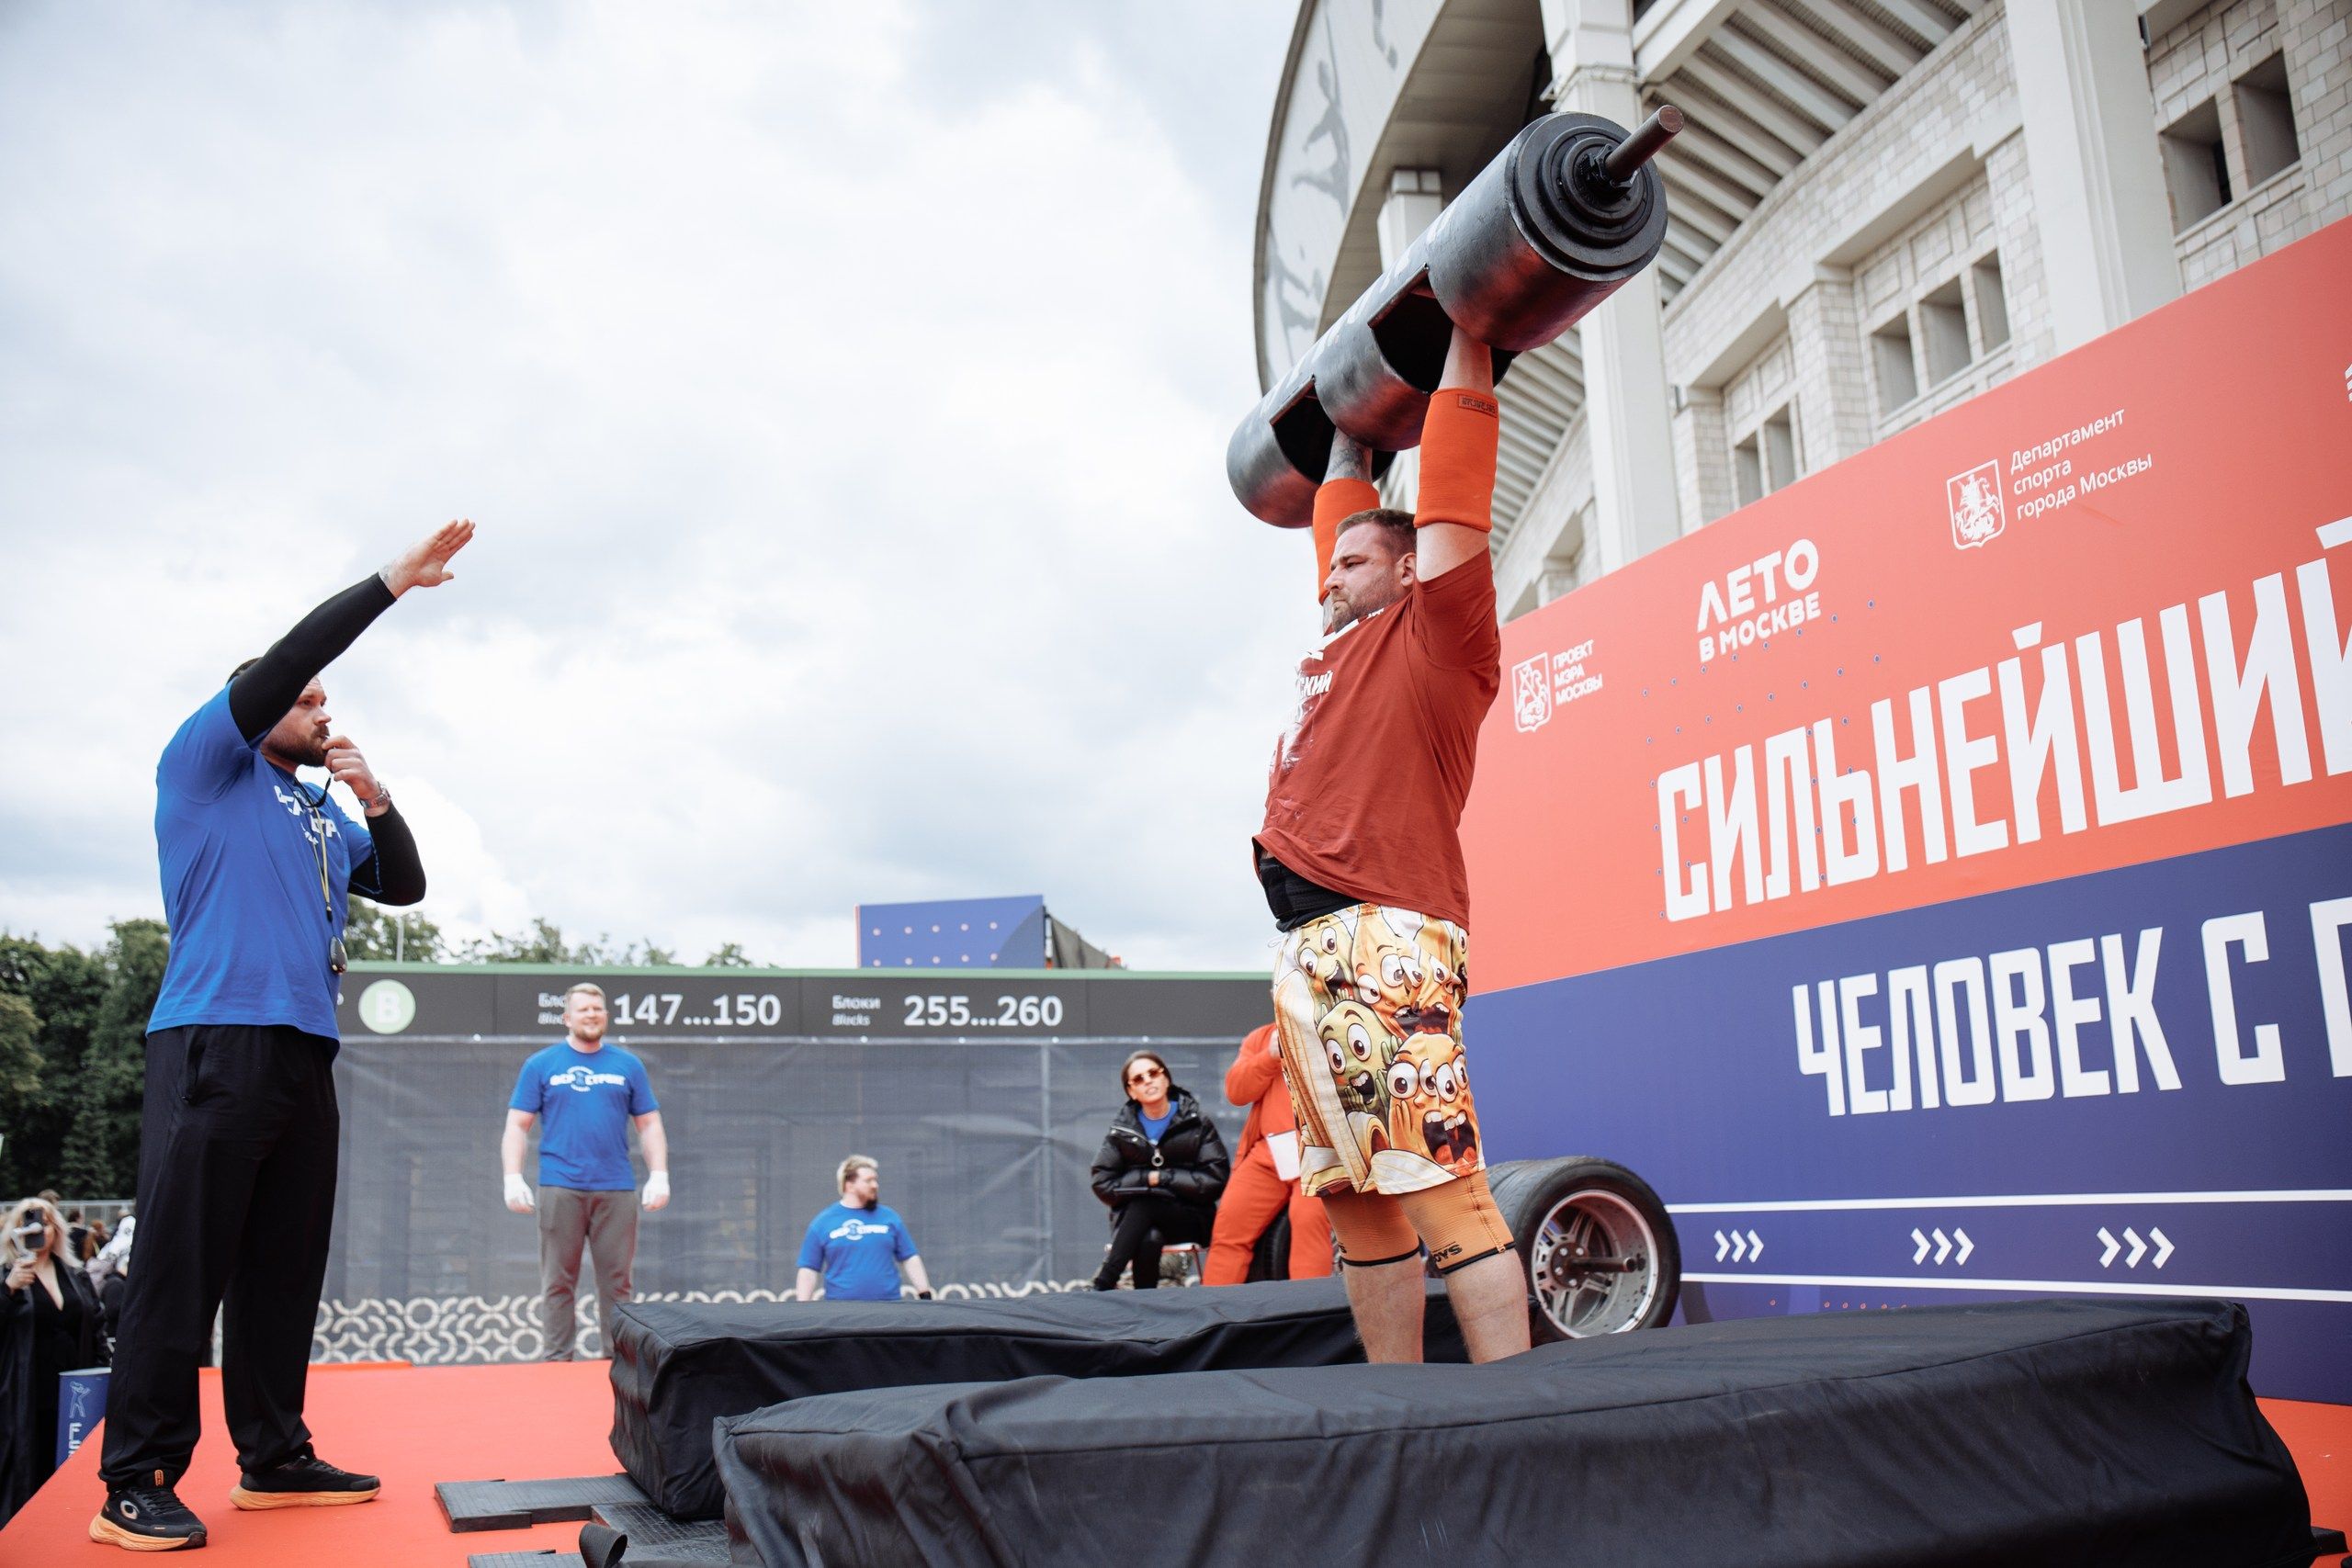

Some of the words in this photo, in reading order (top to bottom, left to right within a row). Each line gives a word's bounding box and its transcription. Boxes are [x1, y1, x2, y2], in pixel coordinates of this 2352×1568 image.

[2010, 409, 2124, 475] Департамент
[2013, 459, 2072, 495] спорта
[2017, 484, 2076, 521] города
[2079, 453, 2153, 496] Москвы
[1697, 538, 1819, 633] ЛЕТО
[1699, 636, 1715, 663] В
[1719, 591, 1822, 656] МОСКВЕ
[1553, 639, 1594, 671] ПРОЕКТ
[1555, 662, 1586, 689] МЭРА
[1555, 672, 1603, 706] МОСКВЫ
[538, 992, 566, 1008] Бло
[614, 993, 781, 1026] 147...150
[831, 994, 881, 1010] Блоки
[903, 995, 1064, 1027] 255...260
[1792, 927, 2182, 1117] ЧЕЛОВЕК
[2200, 910, 2286, 1086] С
